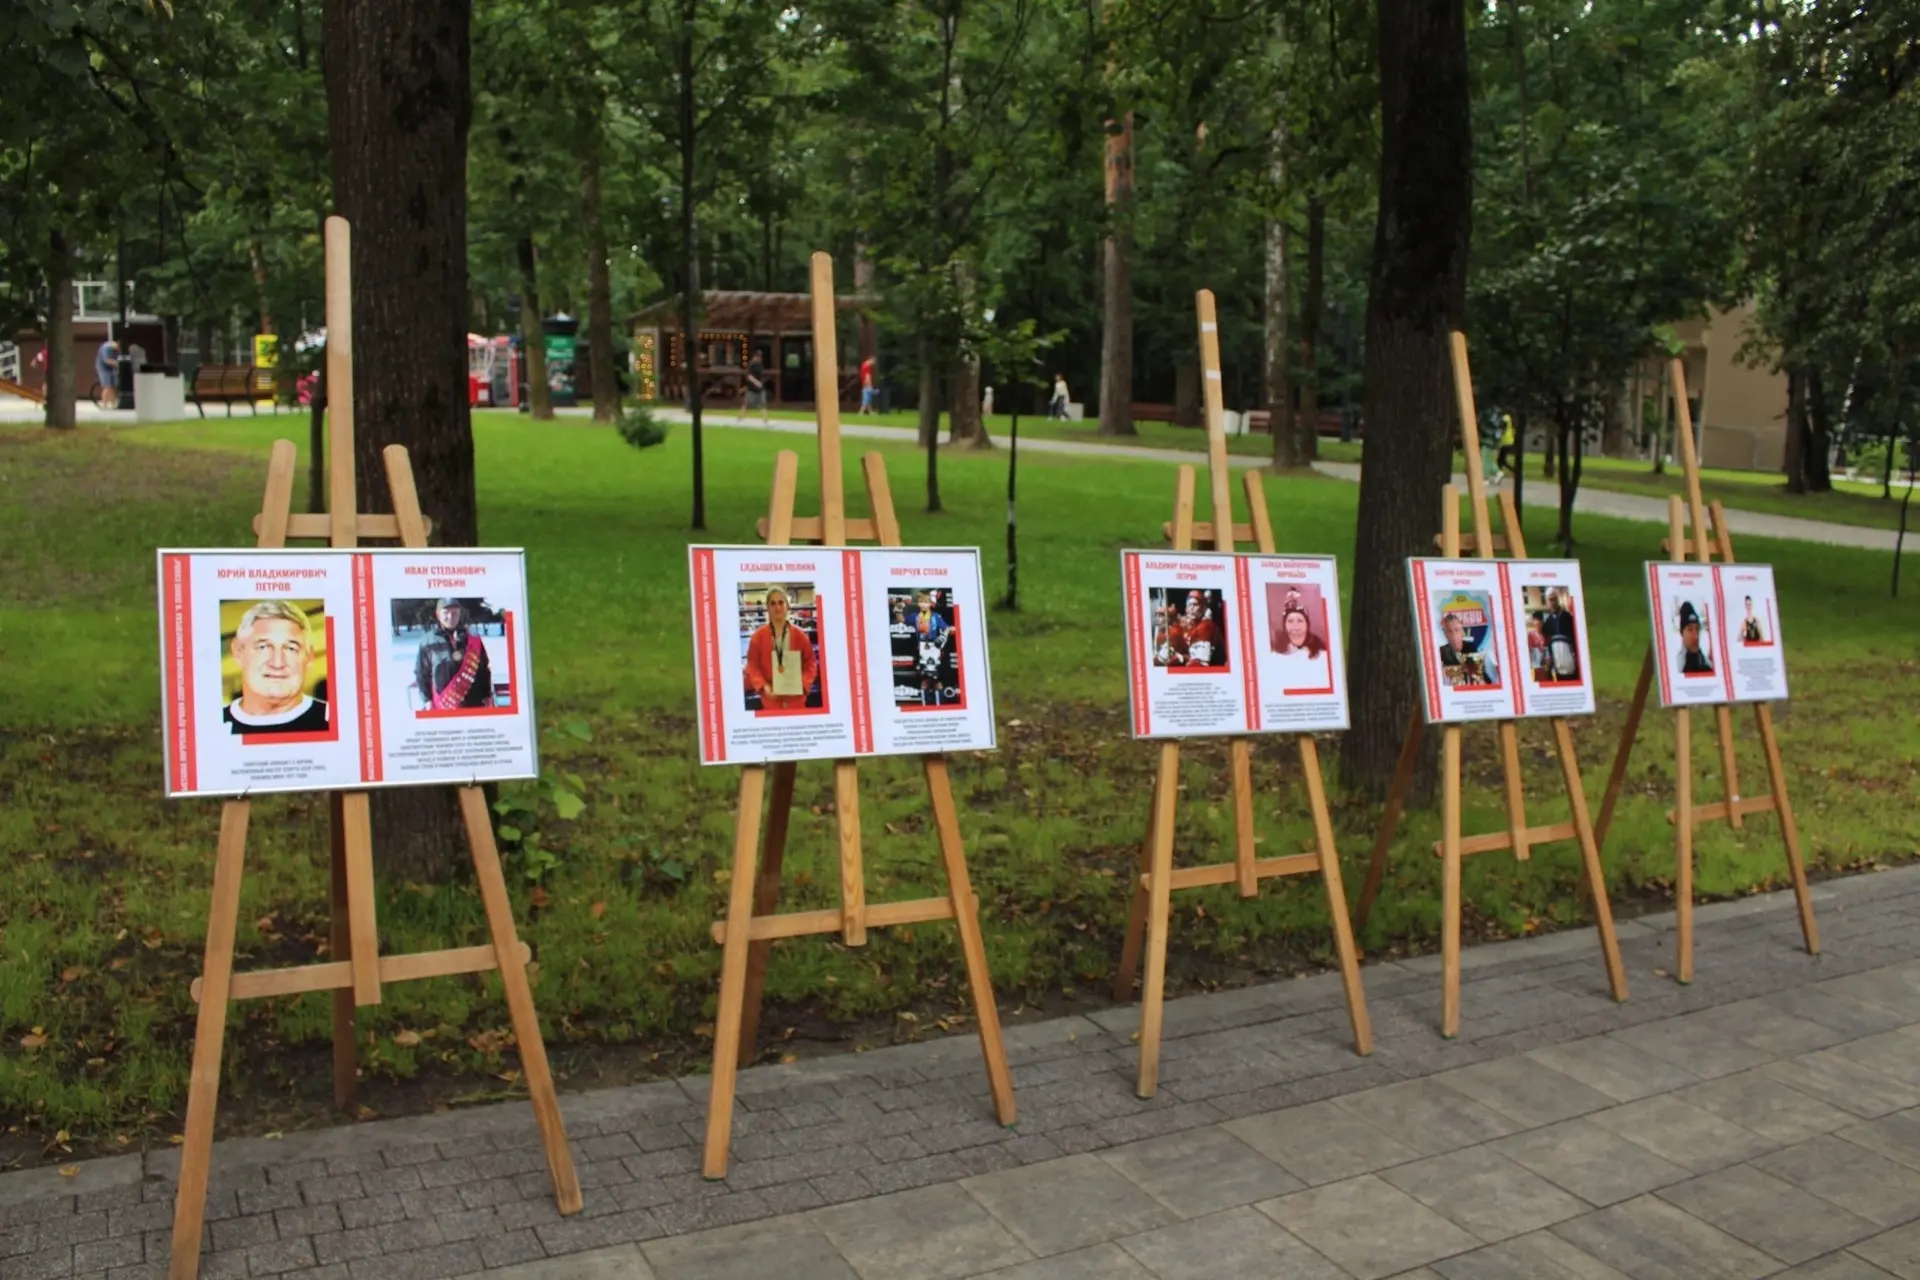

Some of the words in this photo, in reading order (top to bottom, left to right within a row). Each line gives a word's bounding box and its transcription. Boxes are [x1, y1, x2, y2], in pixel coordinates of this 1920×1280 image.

[217, 568, 246, 579] ЮРИЙ
[249, 568, 327, 580] ВЛАДИМИРОВИЧ
[255, 582, 291, 592] ПЕТРОВ
